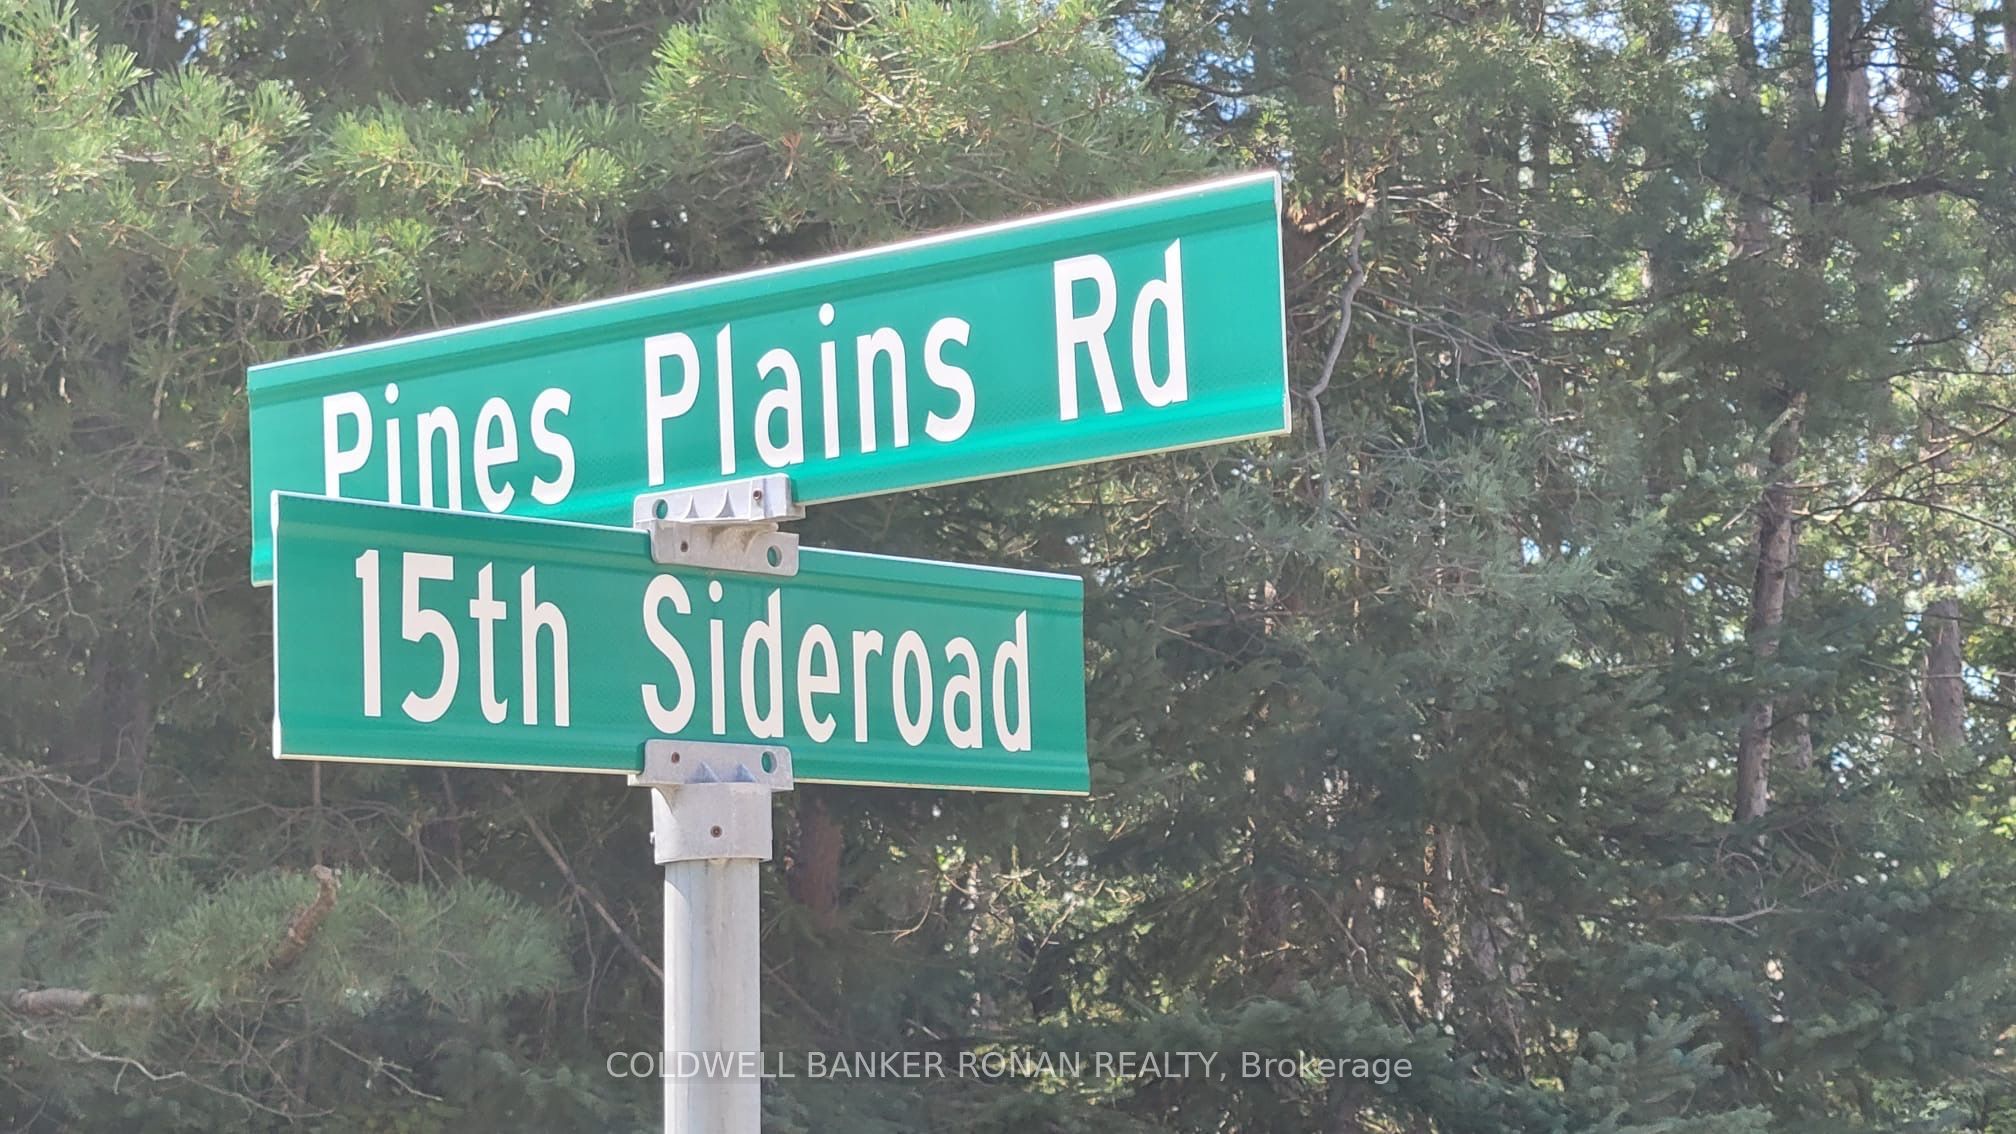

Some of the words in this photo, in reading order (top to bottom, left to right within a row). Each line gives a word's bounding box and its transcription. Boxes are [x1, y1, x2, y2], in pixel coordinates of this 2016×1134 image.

[322, 382, 576, 513] Pines
[644, 302, 977, 487] Plains
[1053, 237, 1189, 422] Rd
[355, 548, 571, 728] 15th
[641, 573, 1032, 752] Sideroad
